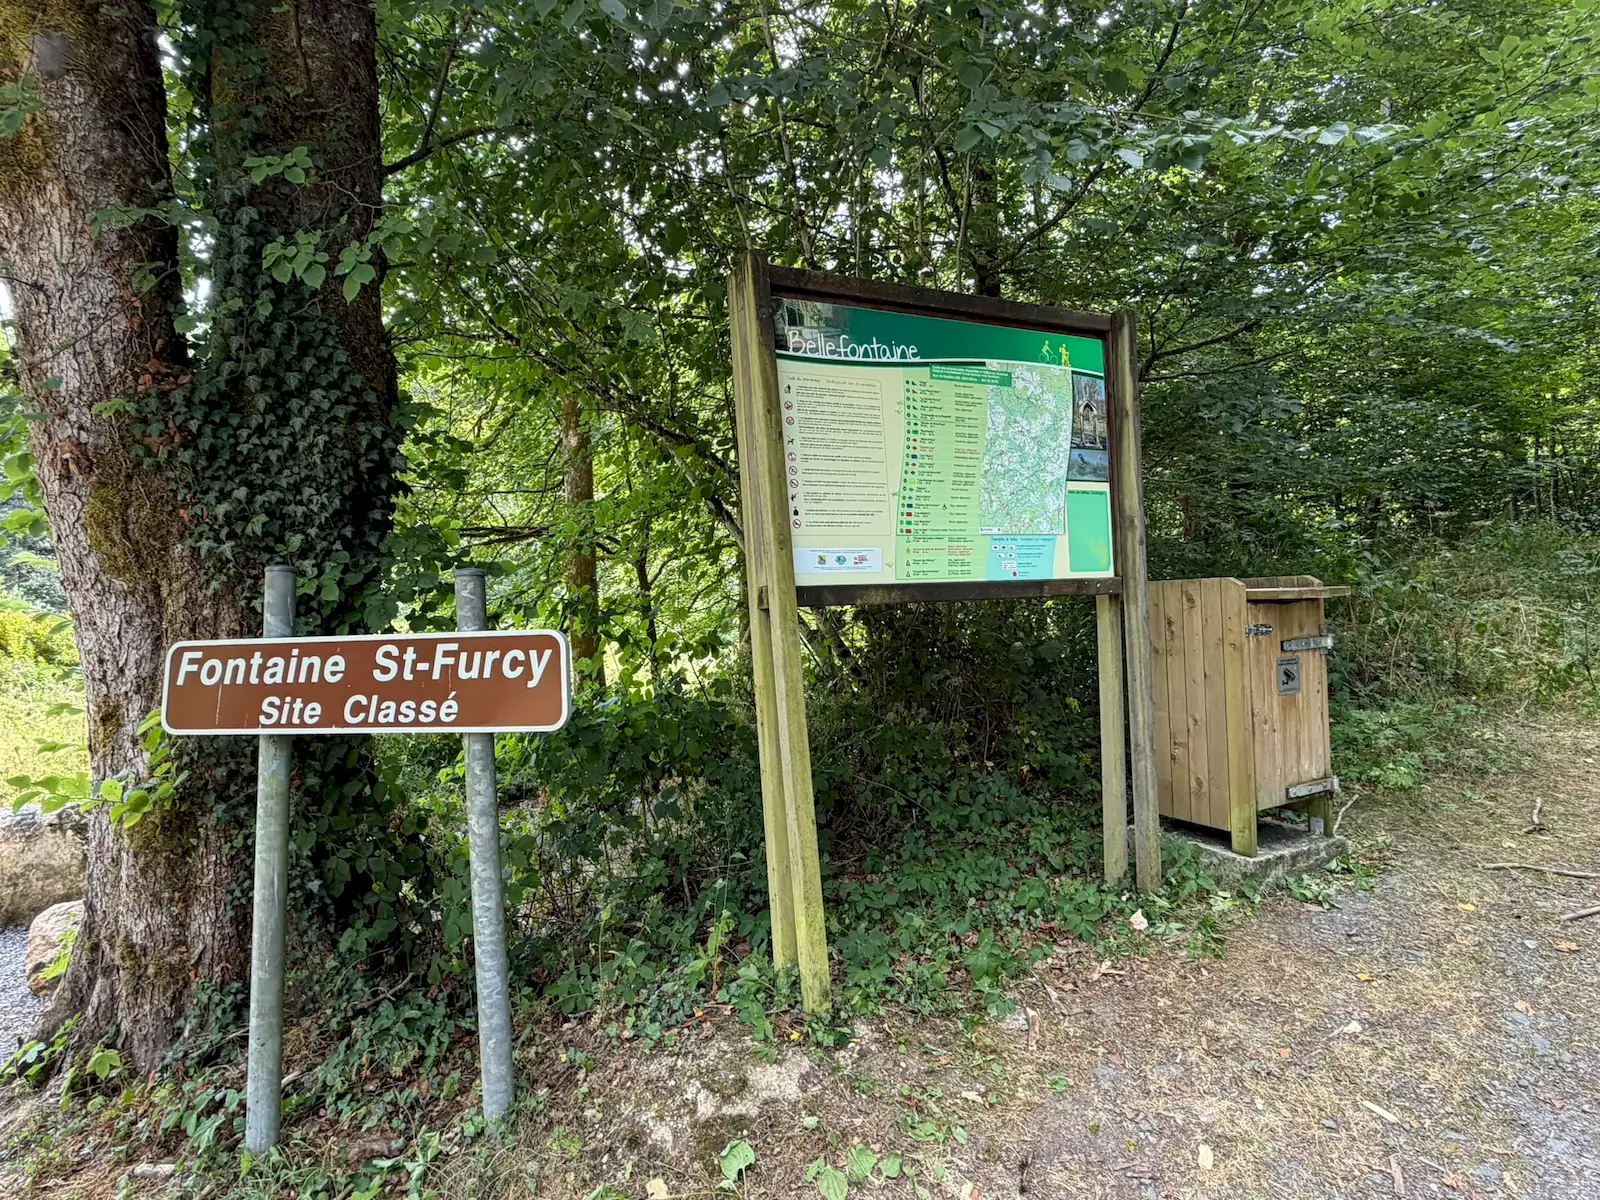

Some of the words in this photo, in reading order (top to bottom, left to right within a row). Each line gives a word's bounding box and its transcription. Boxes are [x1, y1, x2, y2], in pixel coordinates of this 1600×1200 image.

[788, 330, 920, 360] Bellefontaine
[176, 648, 346, 686] Fontaine
[372, 643, 552, 688] St-Furcy
[259, 695, 322, 725] Site
[343, 691, 458, 724] Classé
